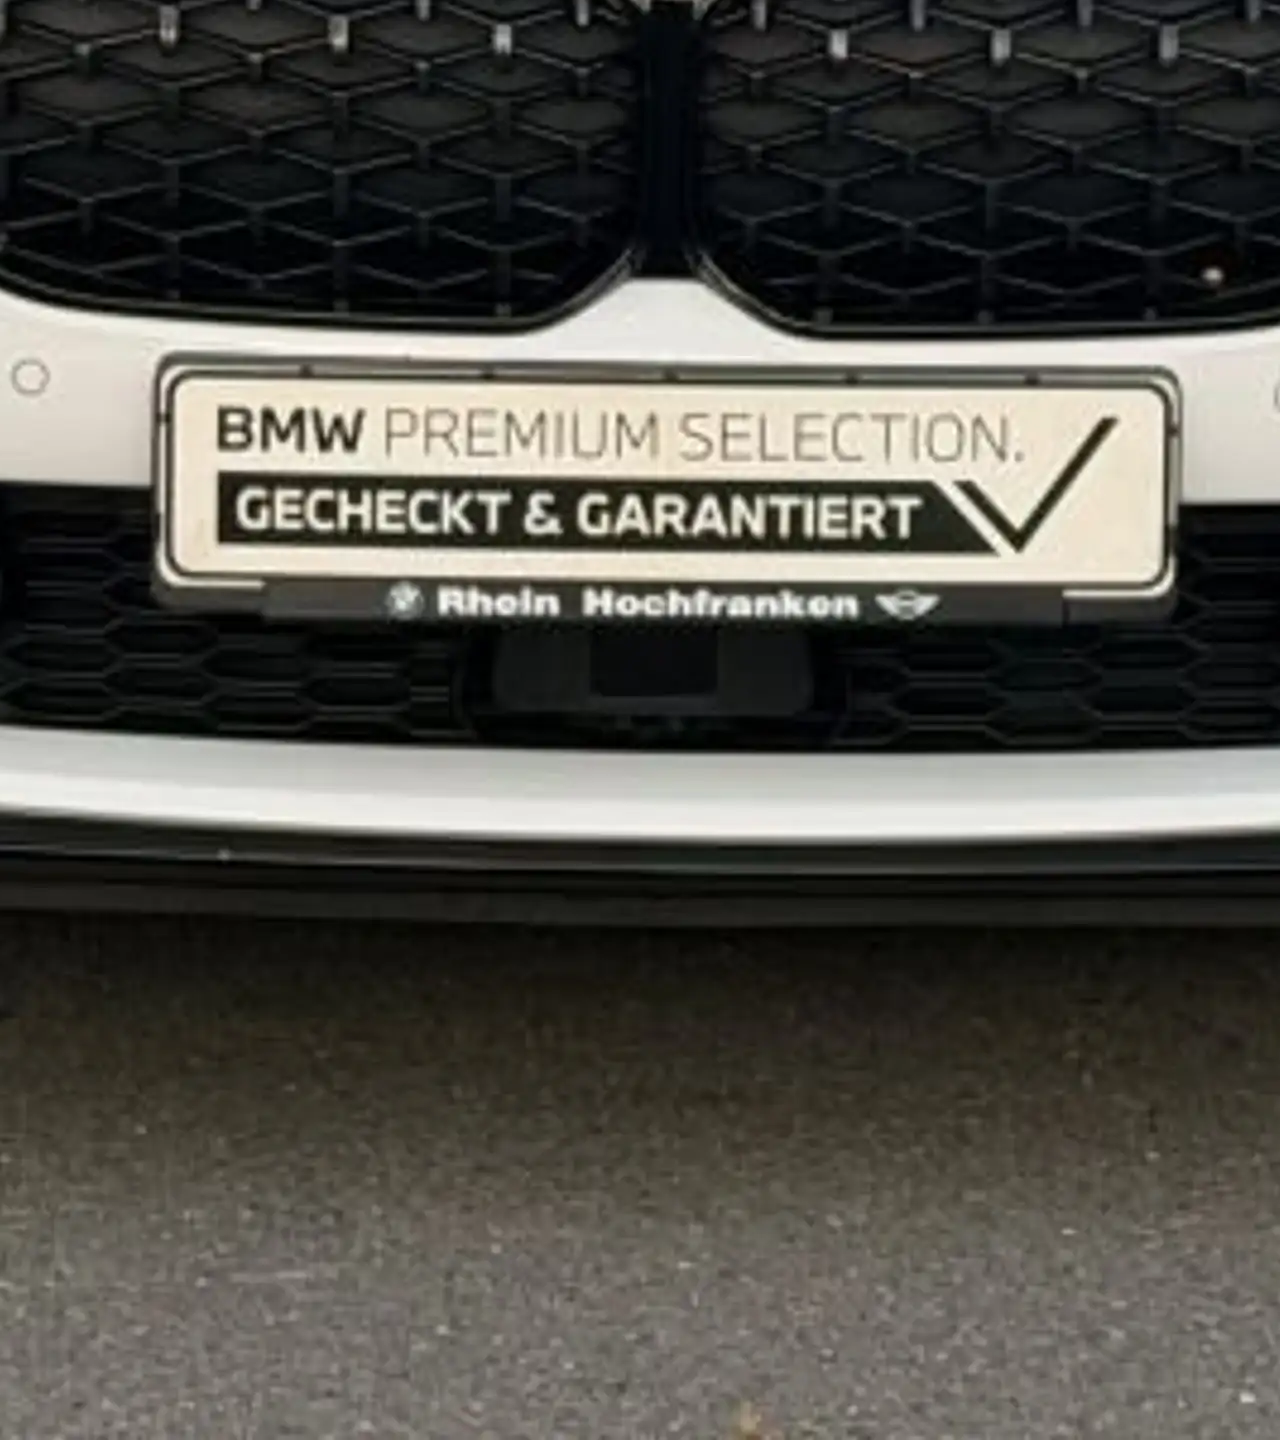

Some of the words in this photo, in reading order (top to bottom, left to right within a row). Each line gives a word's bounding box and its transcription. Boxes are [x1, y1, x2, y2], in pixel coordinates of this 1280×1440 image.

[217, 406, 365, 454] BMW
[385, 408, 659, 459] PREMIUM
[679, 411, 1026, 464] SELECTION.
[236, 486, 512, 535] GECHECKT
[523, 490, 562, 536] &
[577, 492, 922, 539] GARANTIERT
[437, 585, 560, 617] Rhein
[583, 588, 860, 618] Hochfranken
